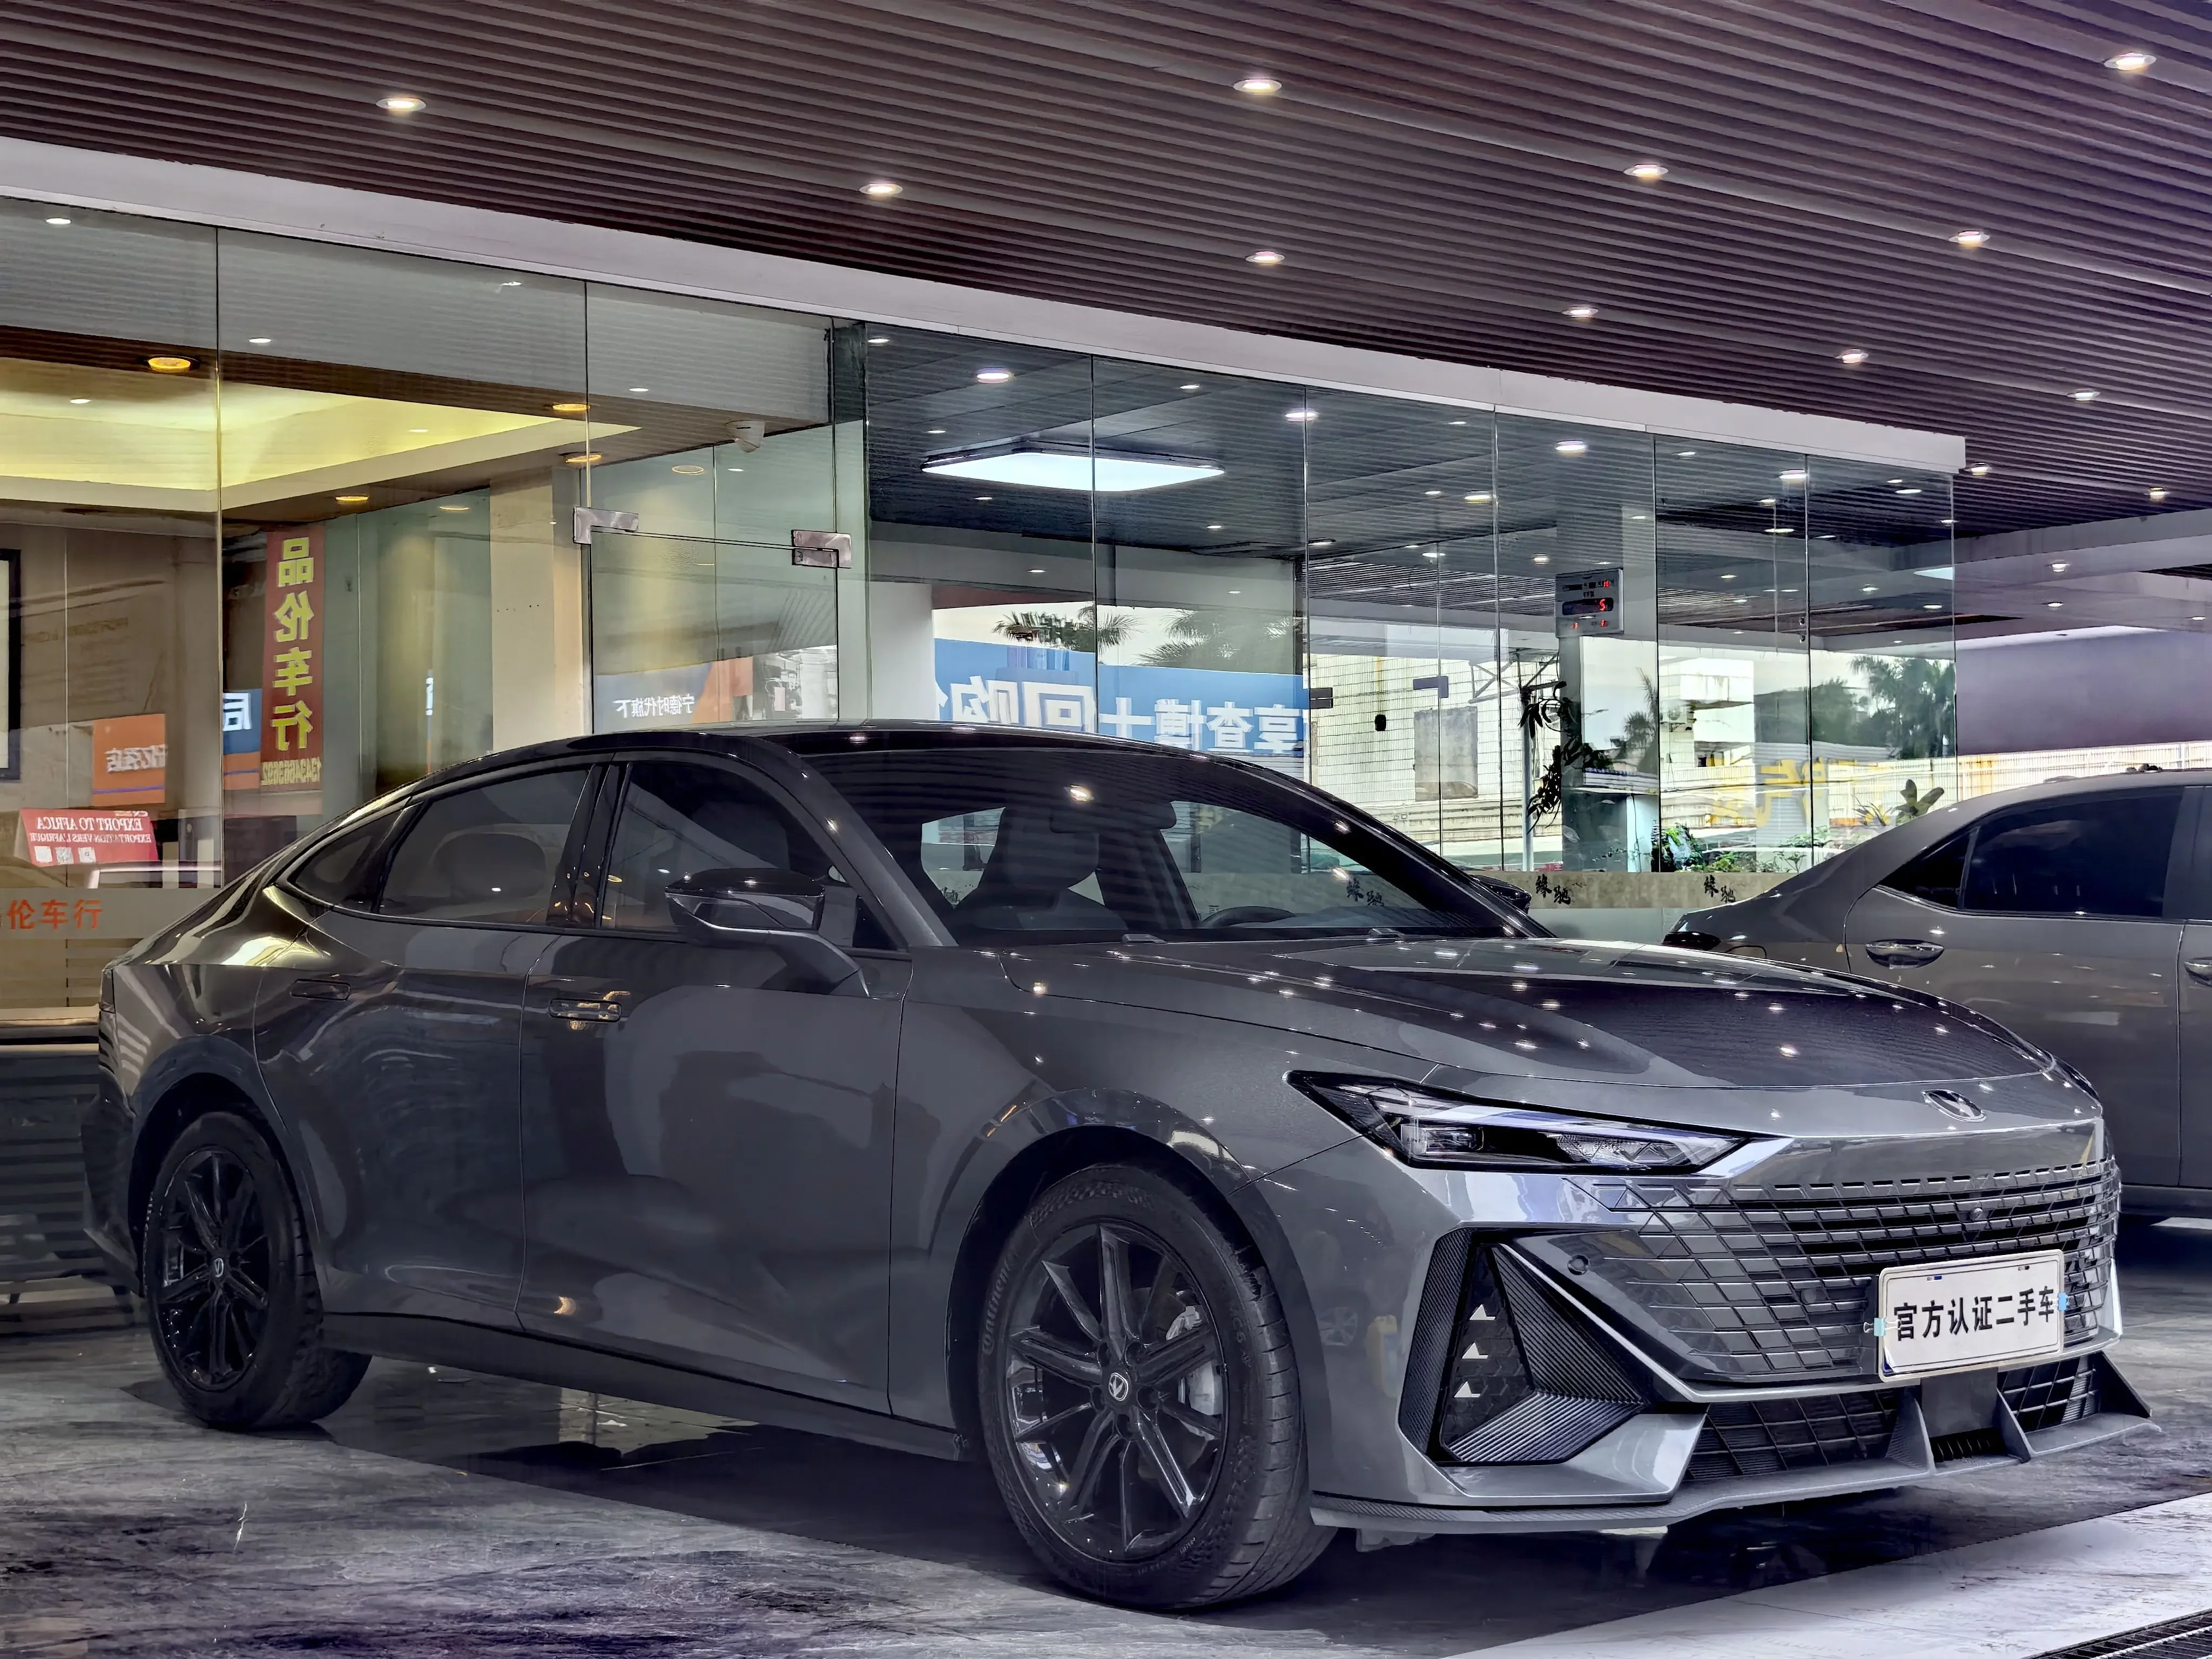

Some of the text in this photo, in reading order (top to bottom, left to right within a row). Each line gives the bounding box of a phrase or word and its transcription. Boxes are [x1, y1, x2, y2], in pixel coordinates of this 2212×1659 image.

[1893, 1286, 2055, 1341] 官方认证二手车
